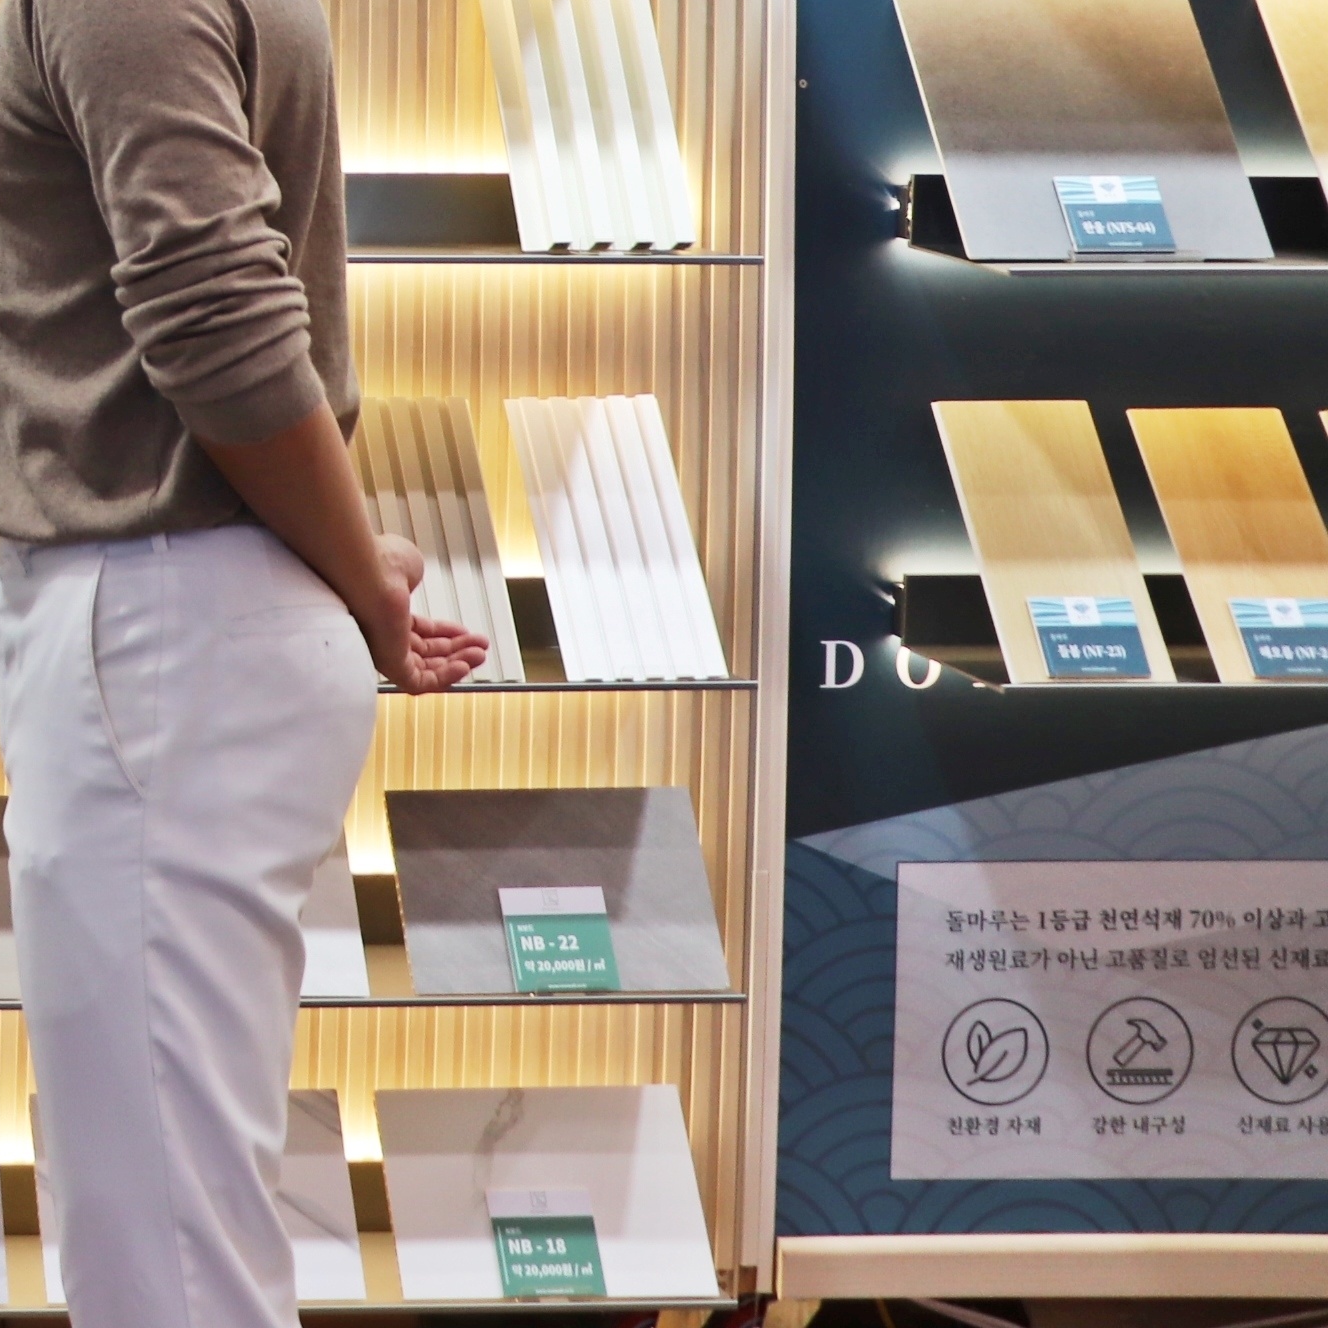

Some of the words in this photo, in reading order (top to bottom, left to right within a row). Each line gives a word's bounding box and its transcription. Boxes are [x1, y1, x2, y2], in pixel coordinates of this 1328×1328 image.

[946, 908, 1031, 932] 돌마루는
[1037, 909, 1091, 932] 1등급
[1099, 907, 1182, 932] 천연석재
[1189, 908, 1236, 929] 70%
[1243, 906, 1306, 931] 이상과
[520, 935, 546, 951] NB
[557, 934, 580, 951] 22
[537, 958, 585, 973] 20,000원
[946, 947, 1051, 971] 재생원료가
[1057, 947, 1098, 971] 아닌
[1105, 946, 1190, 971] 고품질로
[1269, 946, 1328, 971] 신재료
[948, 1115, 1000, 1136] 친환경
[1005, 1115, 1042, 1135] 자재
[1092, 1115, 1127, 1136] 강한
[1132, 1115, 1186, 1136] 내구성
[1238, 1115, 1291, 1136] 신재료
[507, 1238, 533, 1255] NB
[546, 1237, 567, 1255] 18
[525, 1262, 573, 1279] 20,000원
